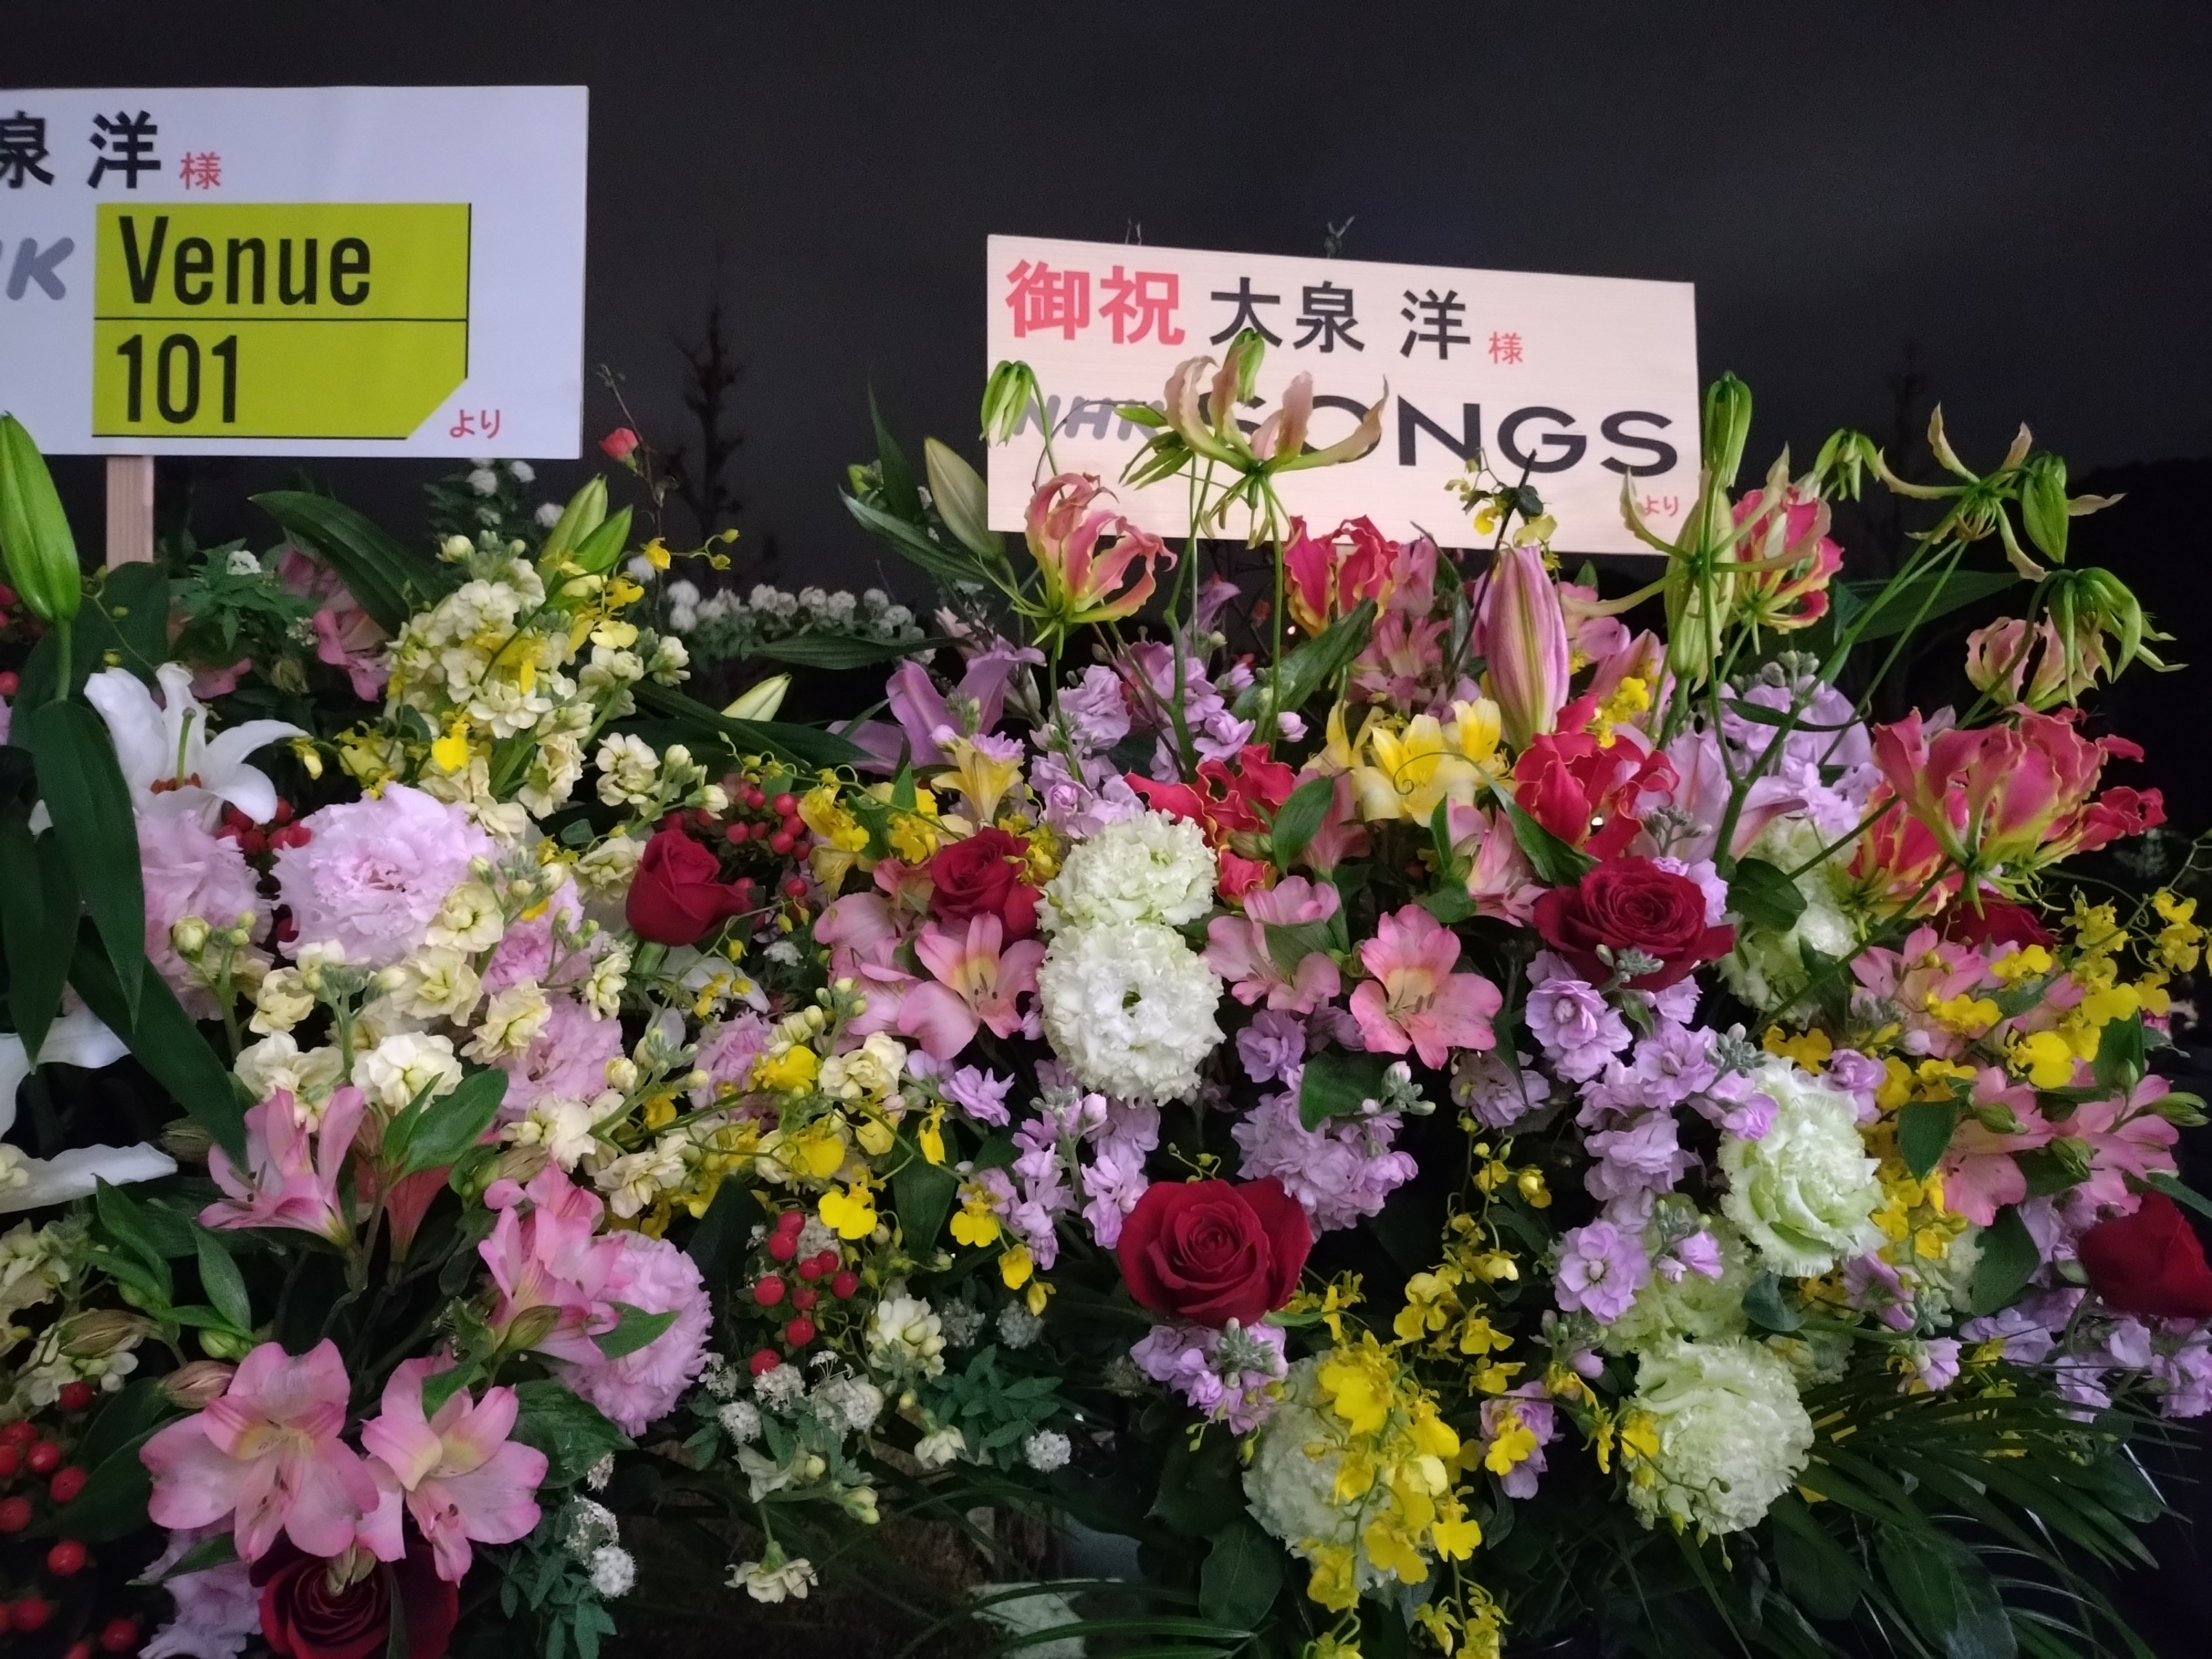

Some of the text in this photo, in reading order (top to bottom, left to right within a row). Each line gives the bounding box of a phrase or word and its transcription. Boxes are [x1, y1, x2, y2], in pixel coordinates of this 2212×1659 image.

[0, 216, 371, 306] K Venue
[1005, 259, 1186, 346] 御祝
[117, 333, 237, 425] 101
[450, 409, 500, 439] より
[1645, 495, 1678, 517] より
